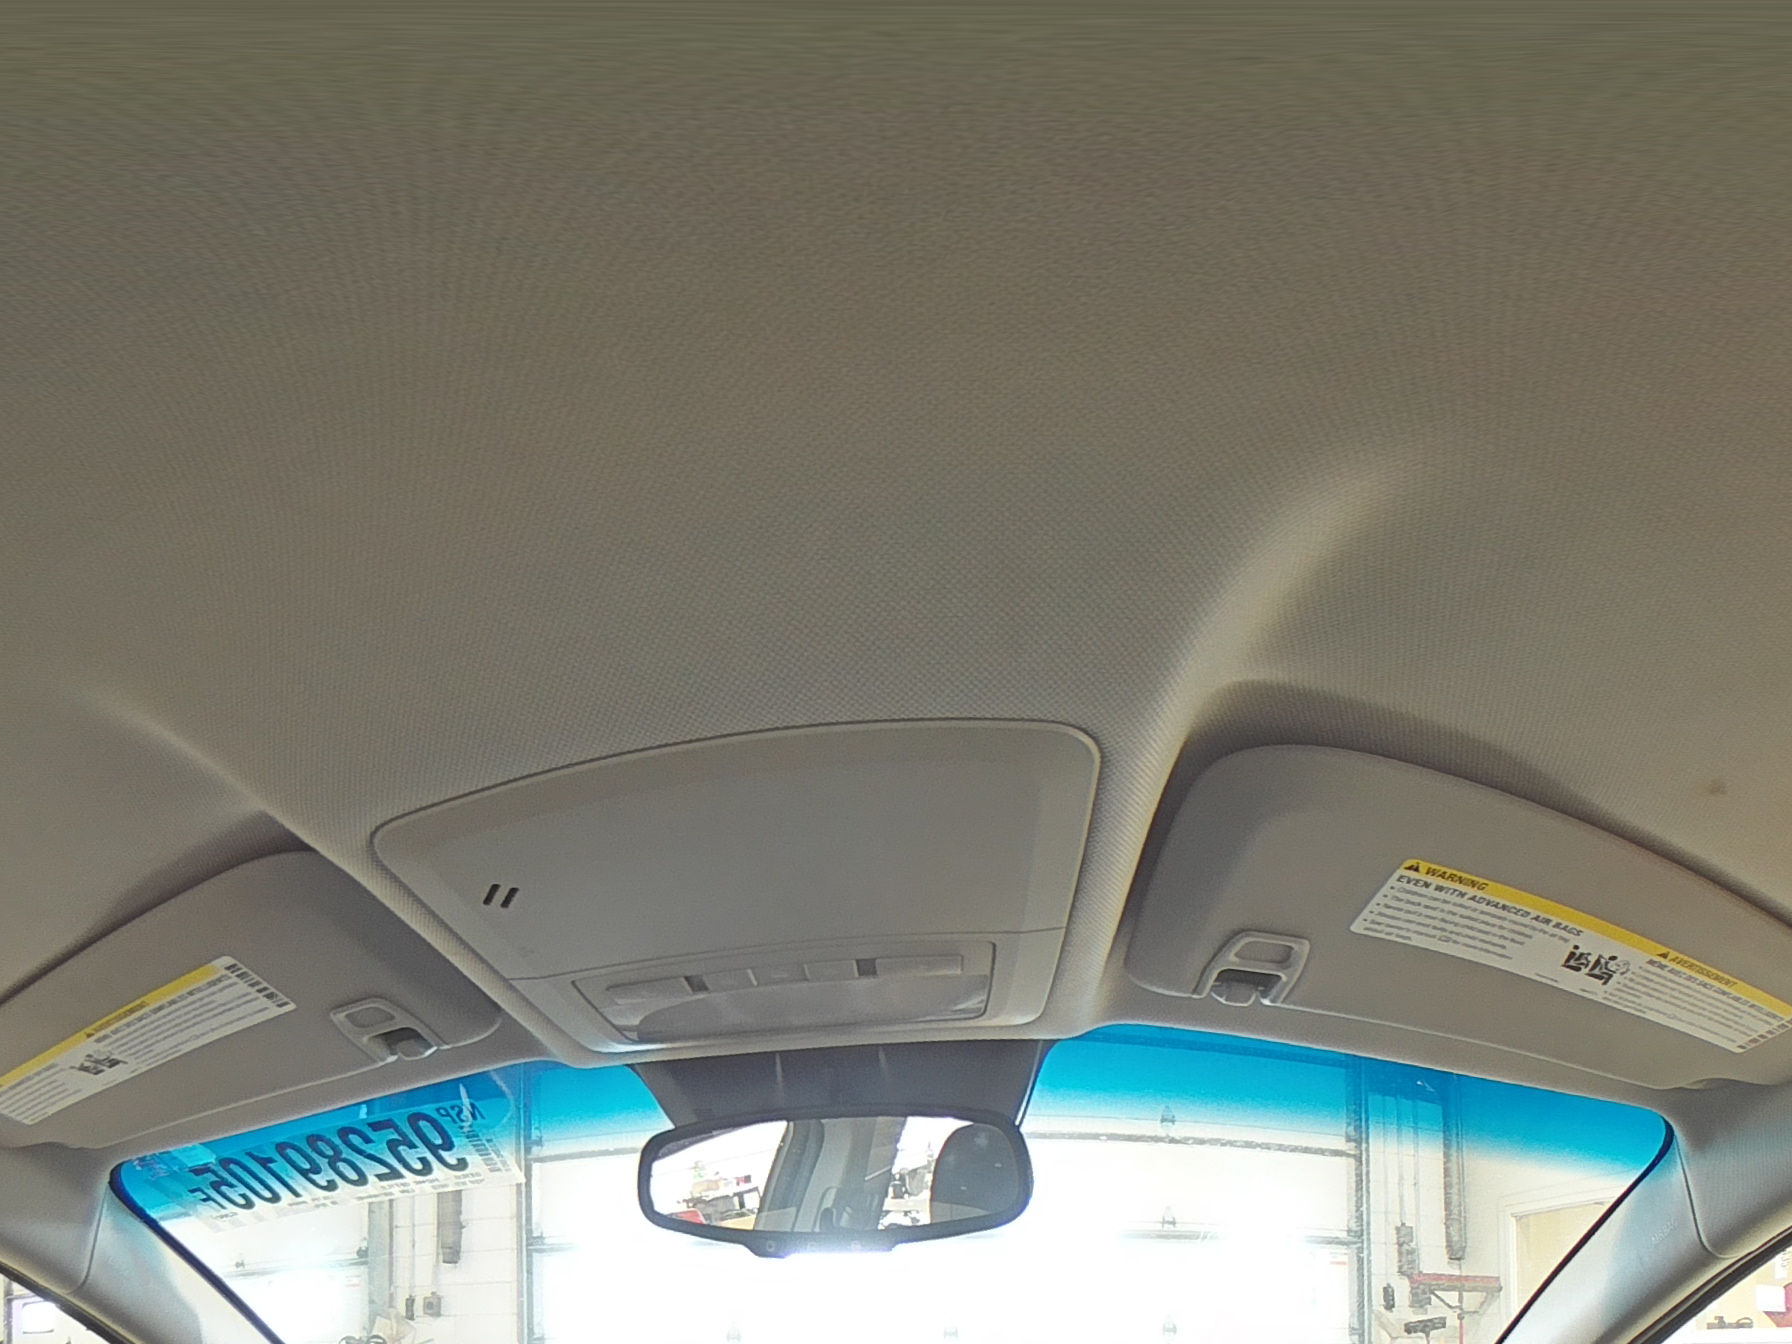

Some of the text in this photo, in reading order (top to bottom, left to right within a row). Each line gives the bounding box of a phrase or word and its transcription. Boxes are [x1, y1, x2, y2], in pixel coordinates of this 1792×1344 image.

[1425, 866, 1489, 891] WARNING
[1396, 875, 1584, 937] EVEN WITH ADVANCED AIR BAGS
